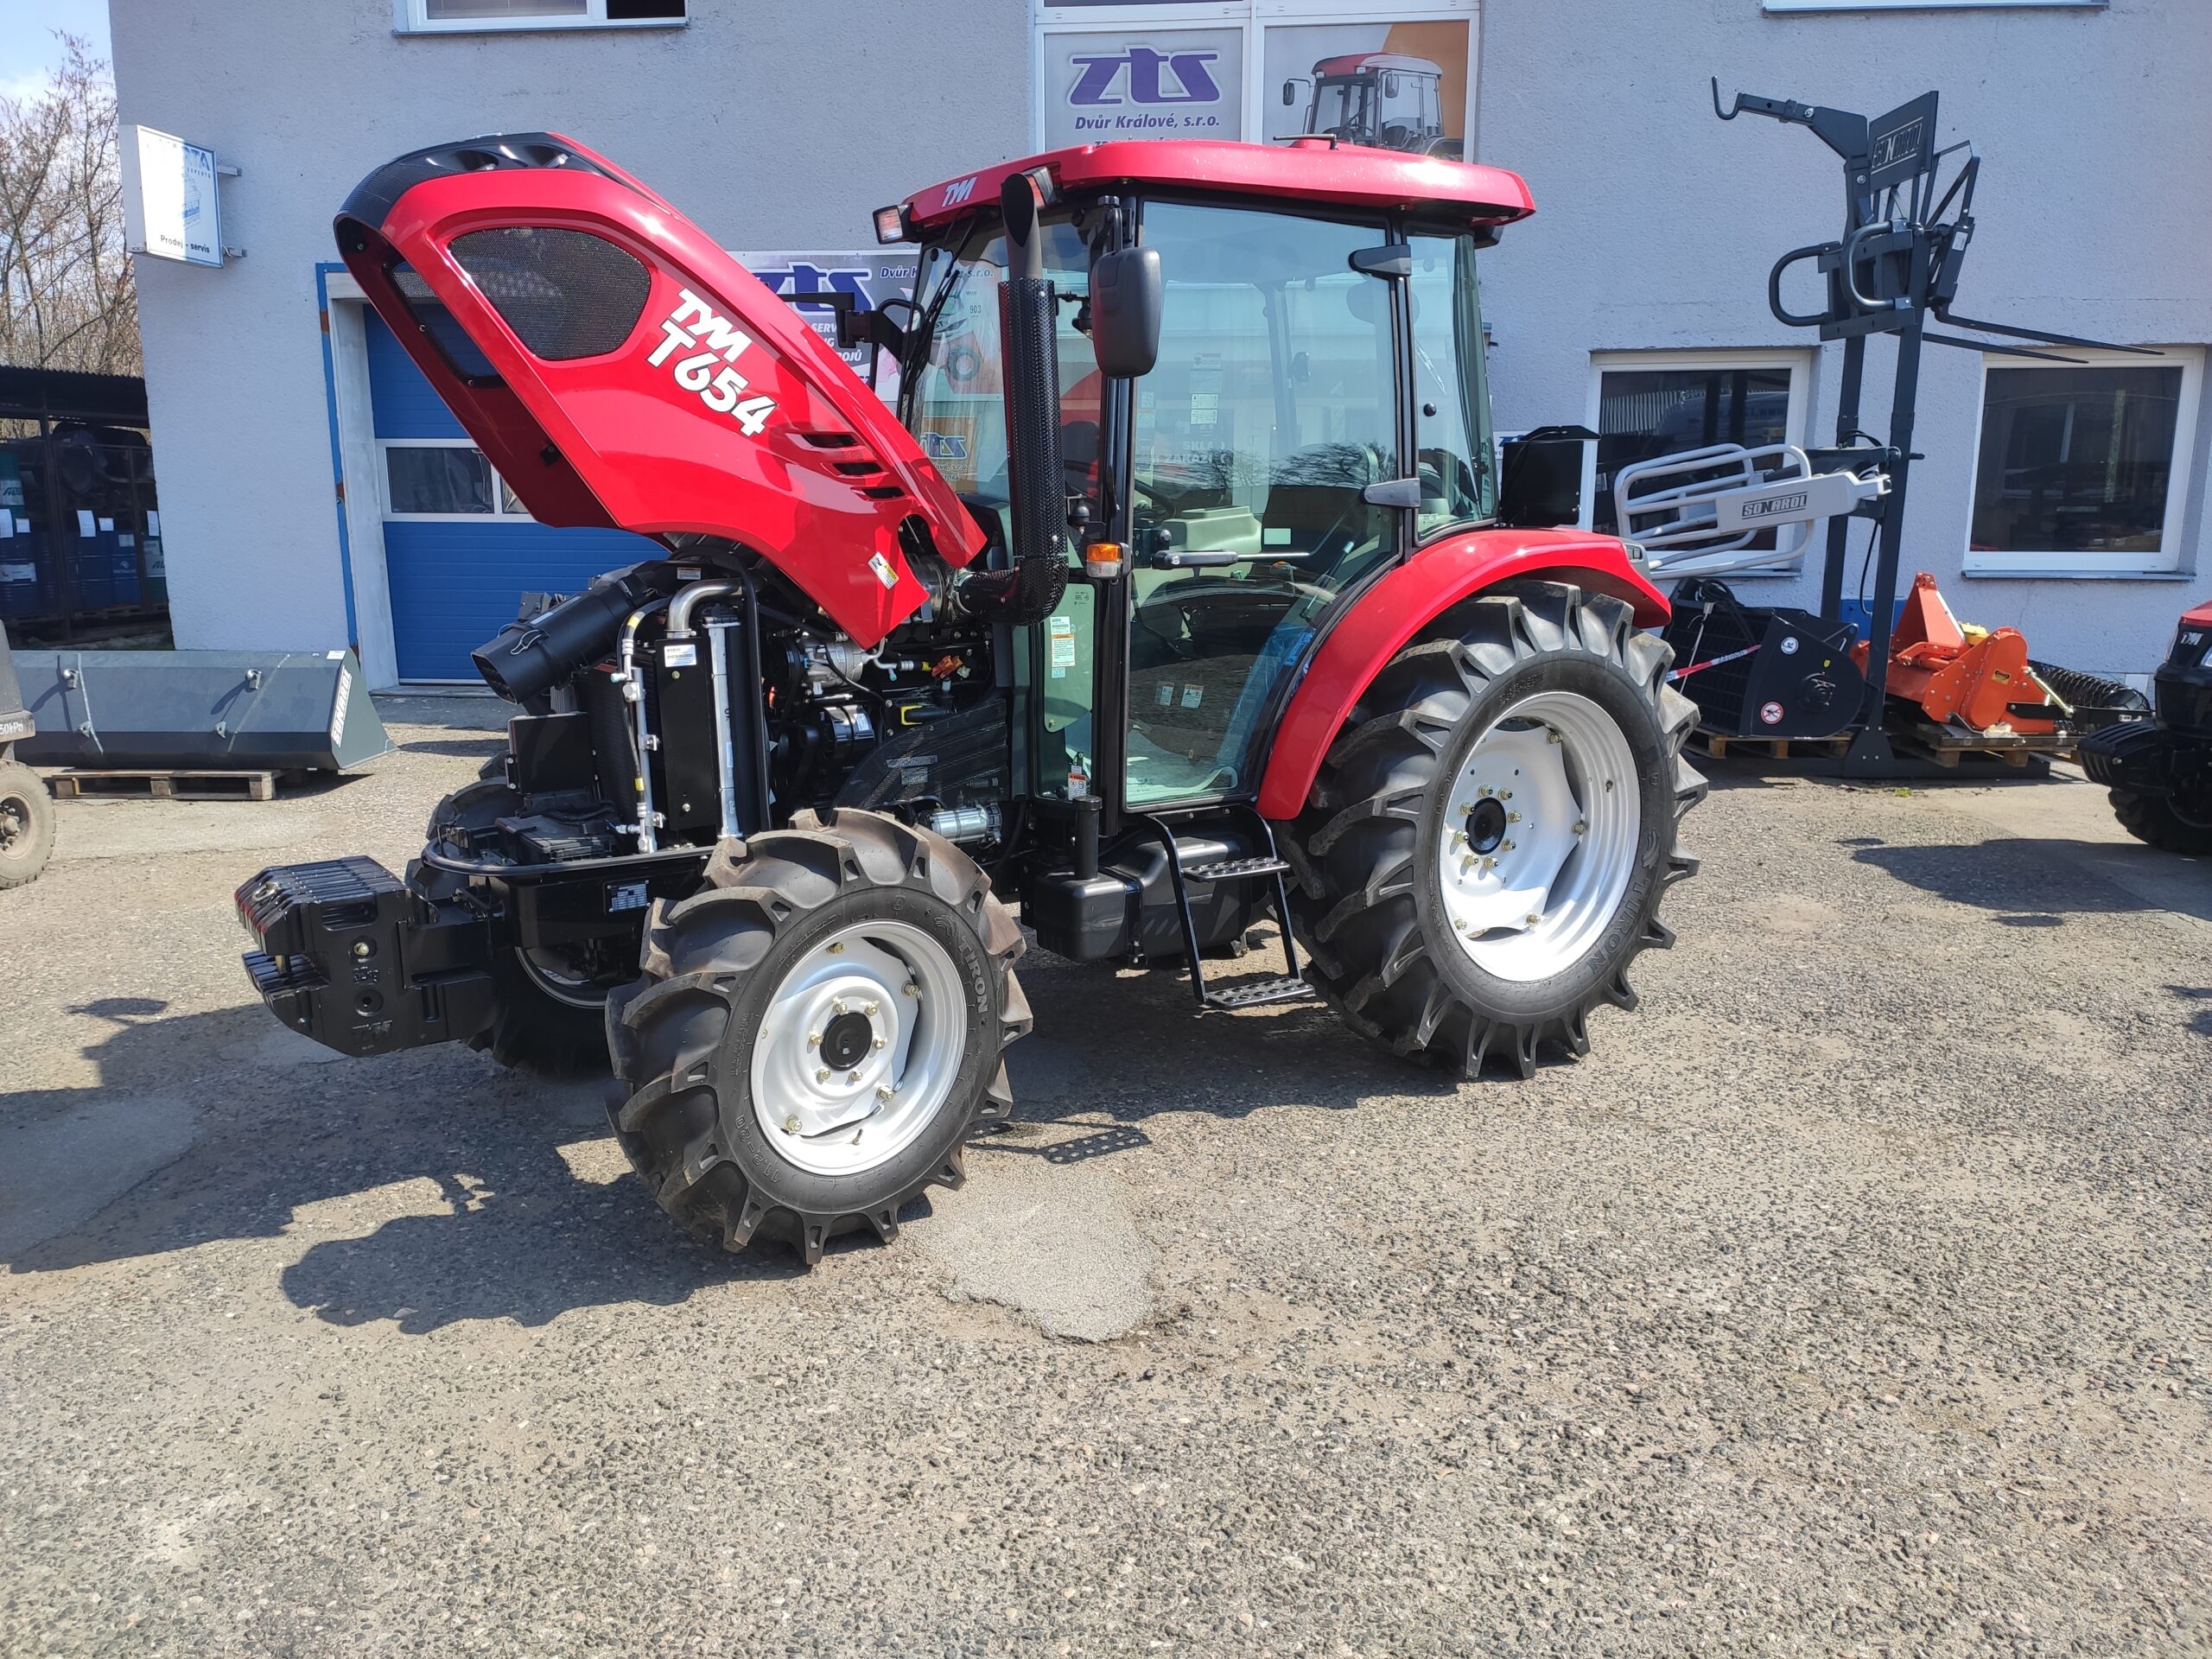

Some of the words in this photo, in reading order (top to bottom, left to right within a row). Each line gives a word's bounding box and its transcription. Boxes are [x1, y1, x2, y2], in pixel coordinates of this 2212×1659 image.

[1075, 114, 1112, 130] Dvůr
[1116, 112, 1179, 130] Králové,
[1183, 115, 1220, 127] s.r.o.
[160, 234, 183, 249] Prodej
[190, 243, 210, 253] servis
[880, 264, 908, 278] Dvůr
[670, 288, 753, 363] TYM
[810, 322, 837, 334] SERV
[646, 318, 779, 437] T654
[1741, 494, 1808, 518] SONAROL
[1587, 876, 1650, 975] TIRON
[958, 935, 988, 1014] TIRON
